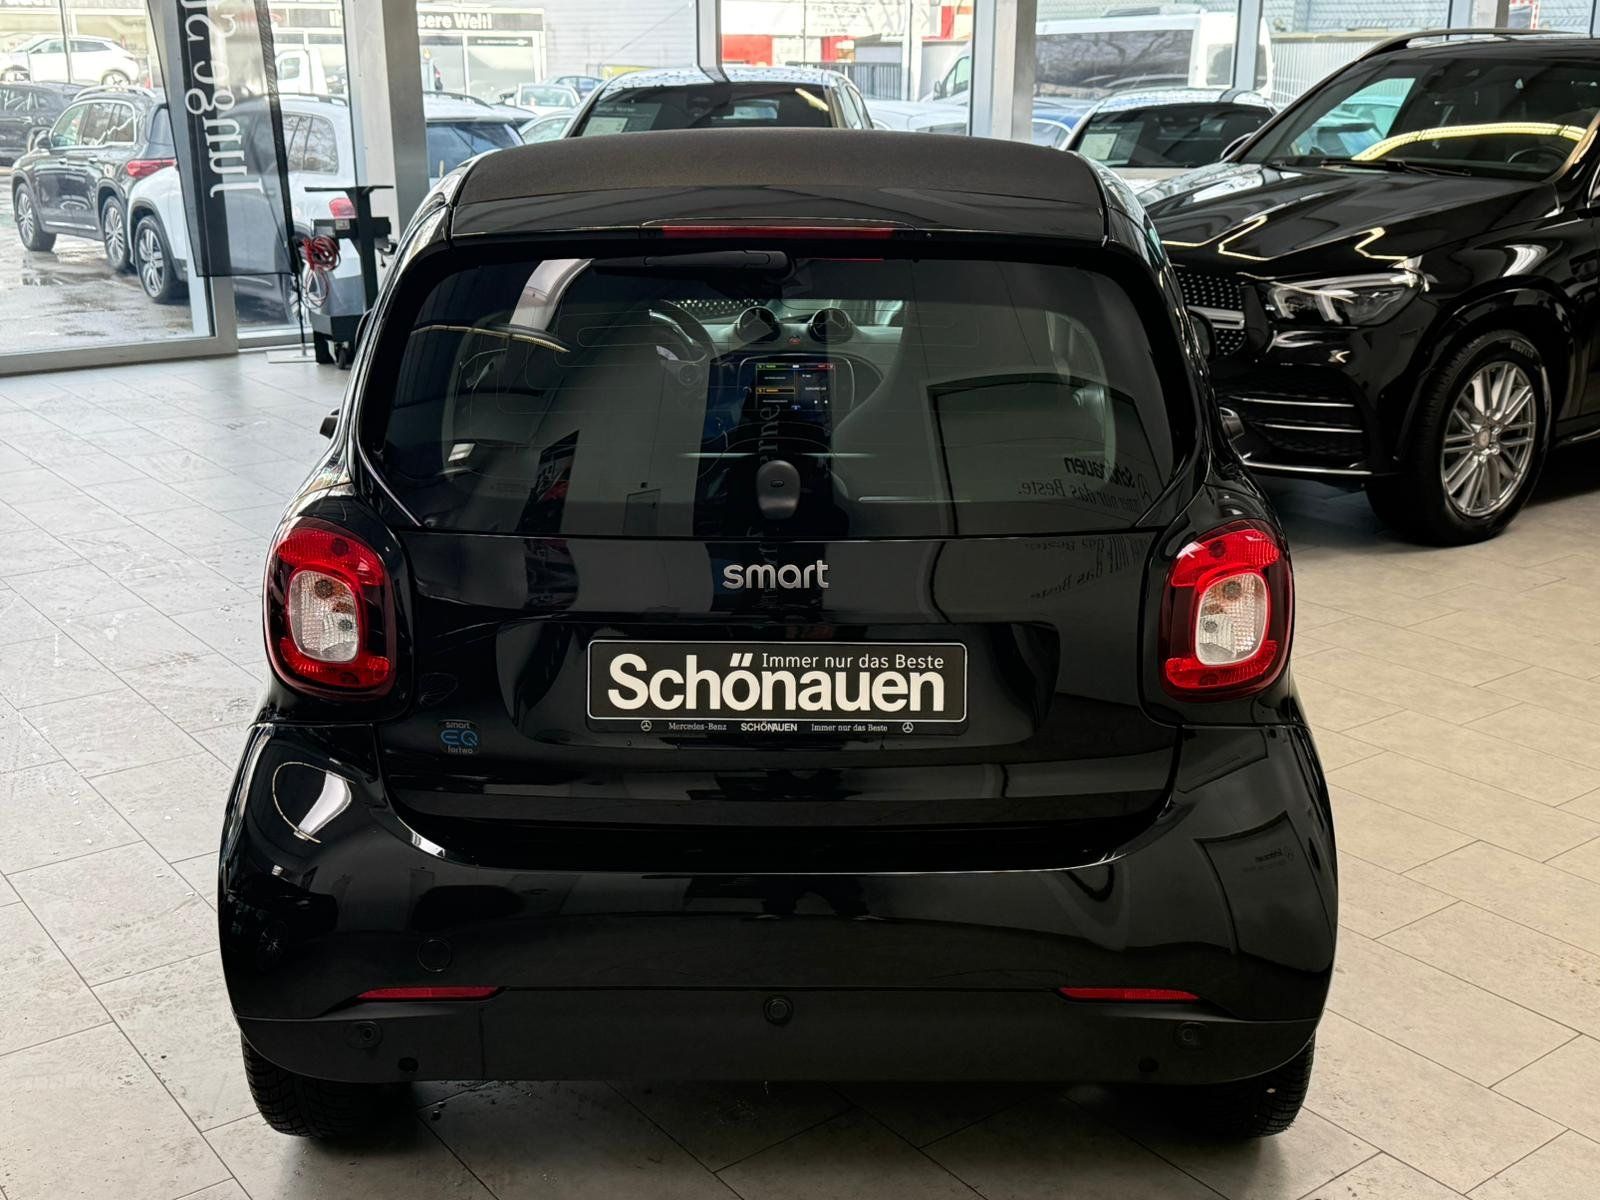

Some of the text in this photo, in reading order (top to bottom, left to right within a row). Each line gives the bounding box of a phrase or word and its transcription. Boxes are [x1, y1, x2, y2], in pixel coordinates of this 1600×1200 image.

[722, 559, 830, 590] smart
[762, 653, 944, 669] Immer nur das Beste
[607, 652, 945, 712] Schönauen
[668, 721, 888, 732] Mercedes-Benz SCHÖNAUEN Immer nur das Beste
